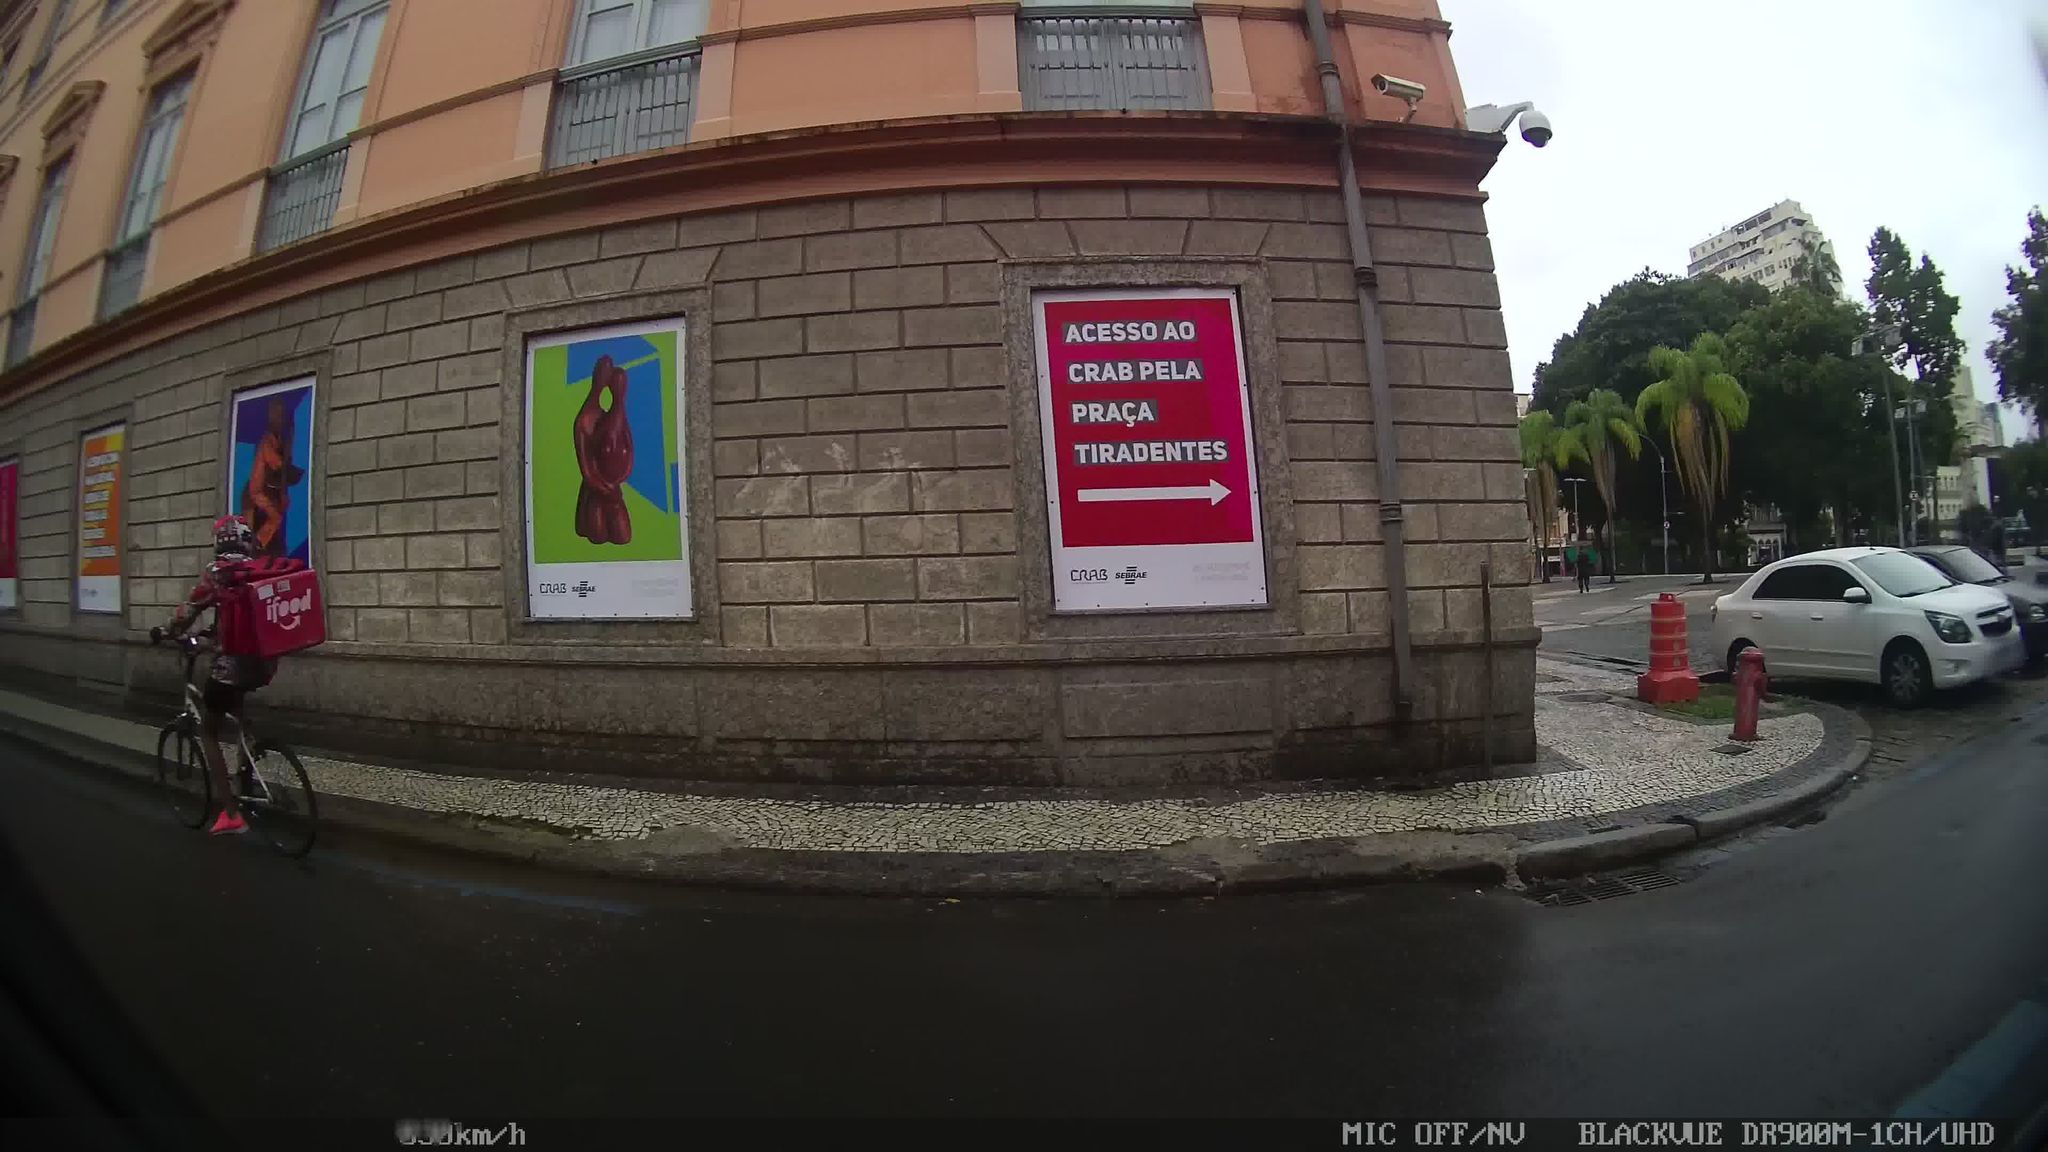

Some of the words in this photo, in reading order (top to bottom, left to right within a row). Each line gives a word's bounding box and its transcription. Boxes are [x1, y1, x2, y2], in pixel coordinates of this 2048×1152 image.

[1065, 323, 1158, 343] ACESSO
[1163, 321, 1195, 341] AO
[1068, 362, 1133, 383] CRAB
[1140, 360, 1202, 381] PELA
[1072, 401, 1154, 427] PRAÇA
[1074, 441, 1228, 464] TIRADENTES
[1070, 568, 1108, 582] CRAB
[1115, 571, 1148, 579] SEBRAE
